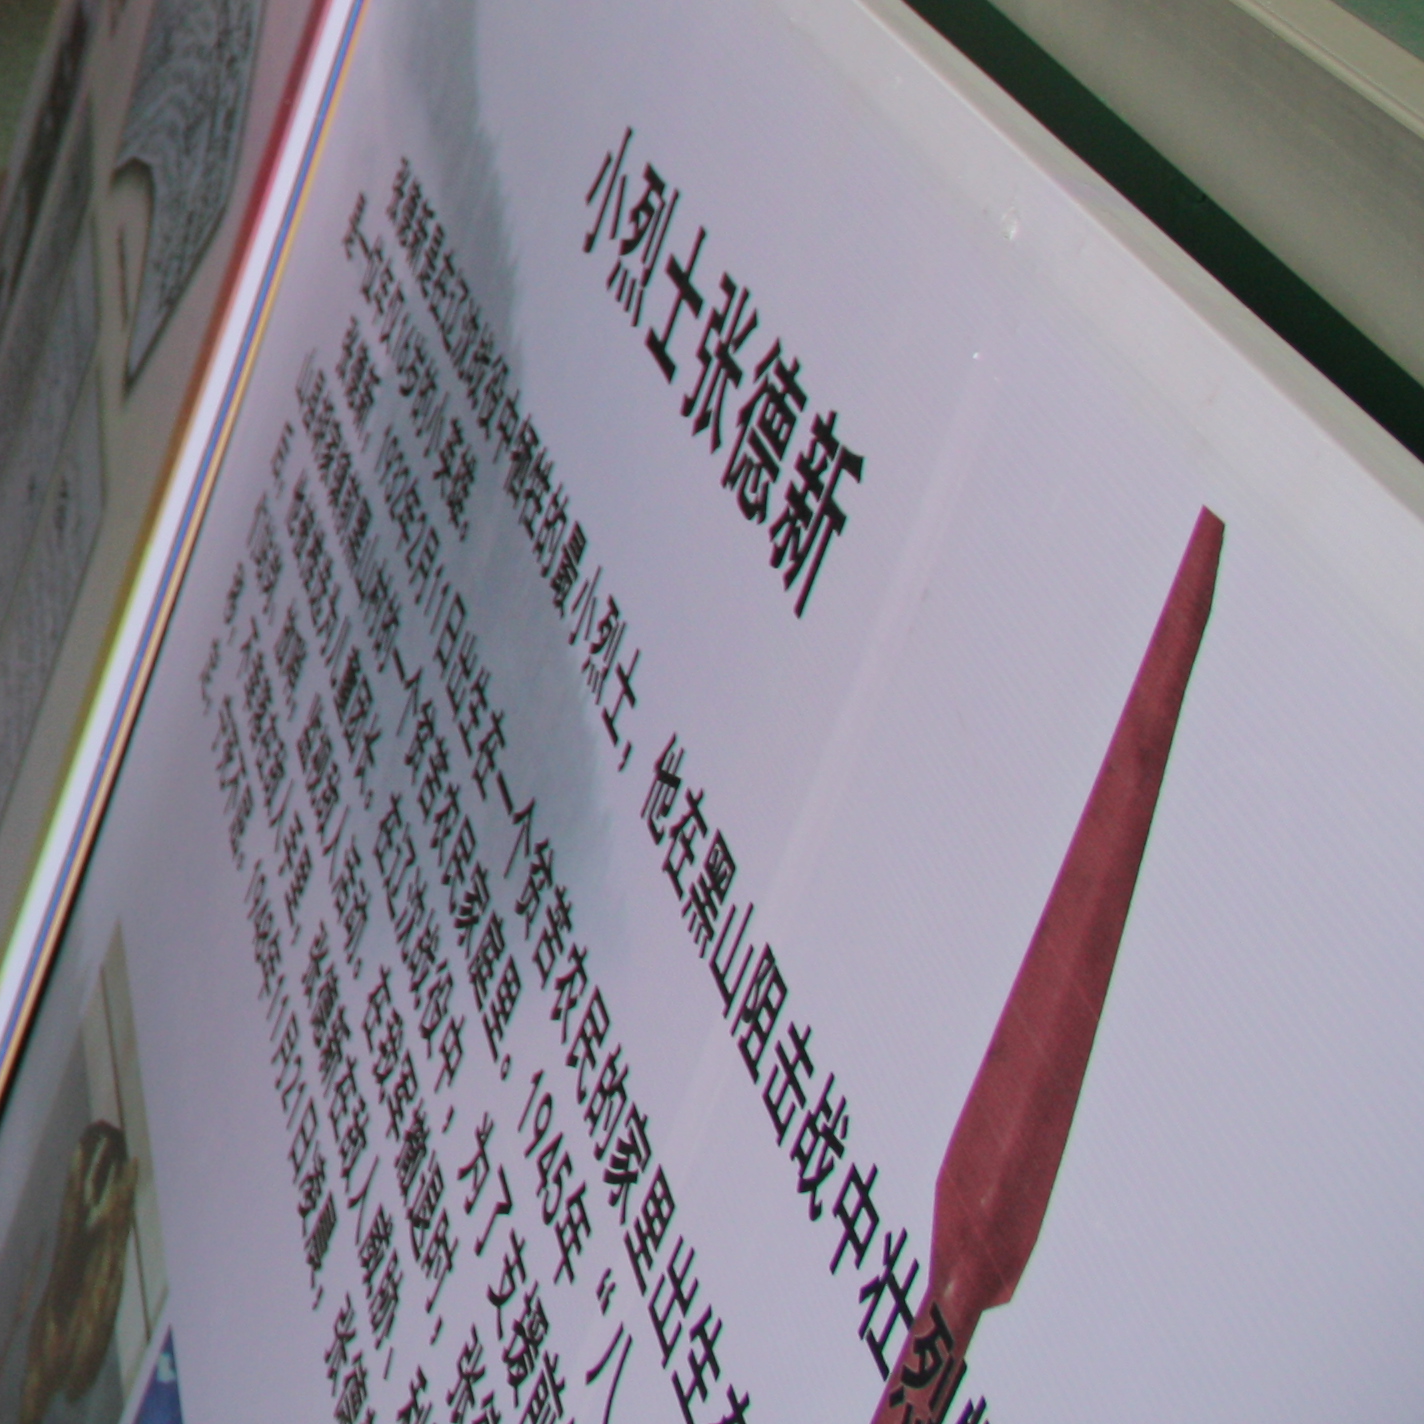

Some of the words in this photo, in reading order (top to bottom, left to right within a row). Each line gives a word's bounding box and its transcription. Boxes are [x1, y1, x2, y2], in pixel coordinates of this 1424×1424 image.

[386, 157, 988, 1424] 张德新是在辽沈战役中牺牲的最小烈士，他在黑山阻击战中壮烈
[583, 125, 866, 619] 小烈士张德新
